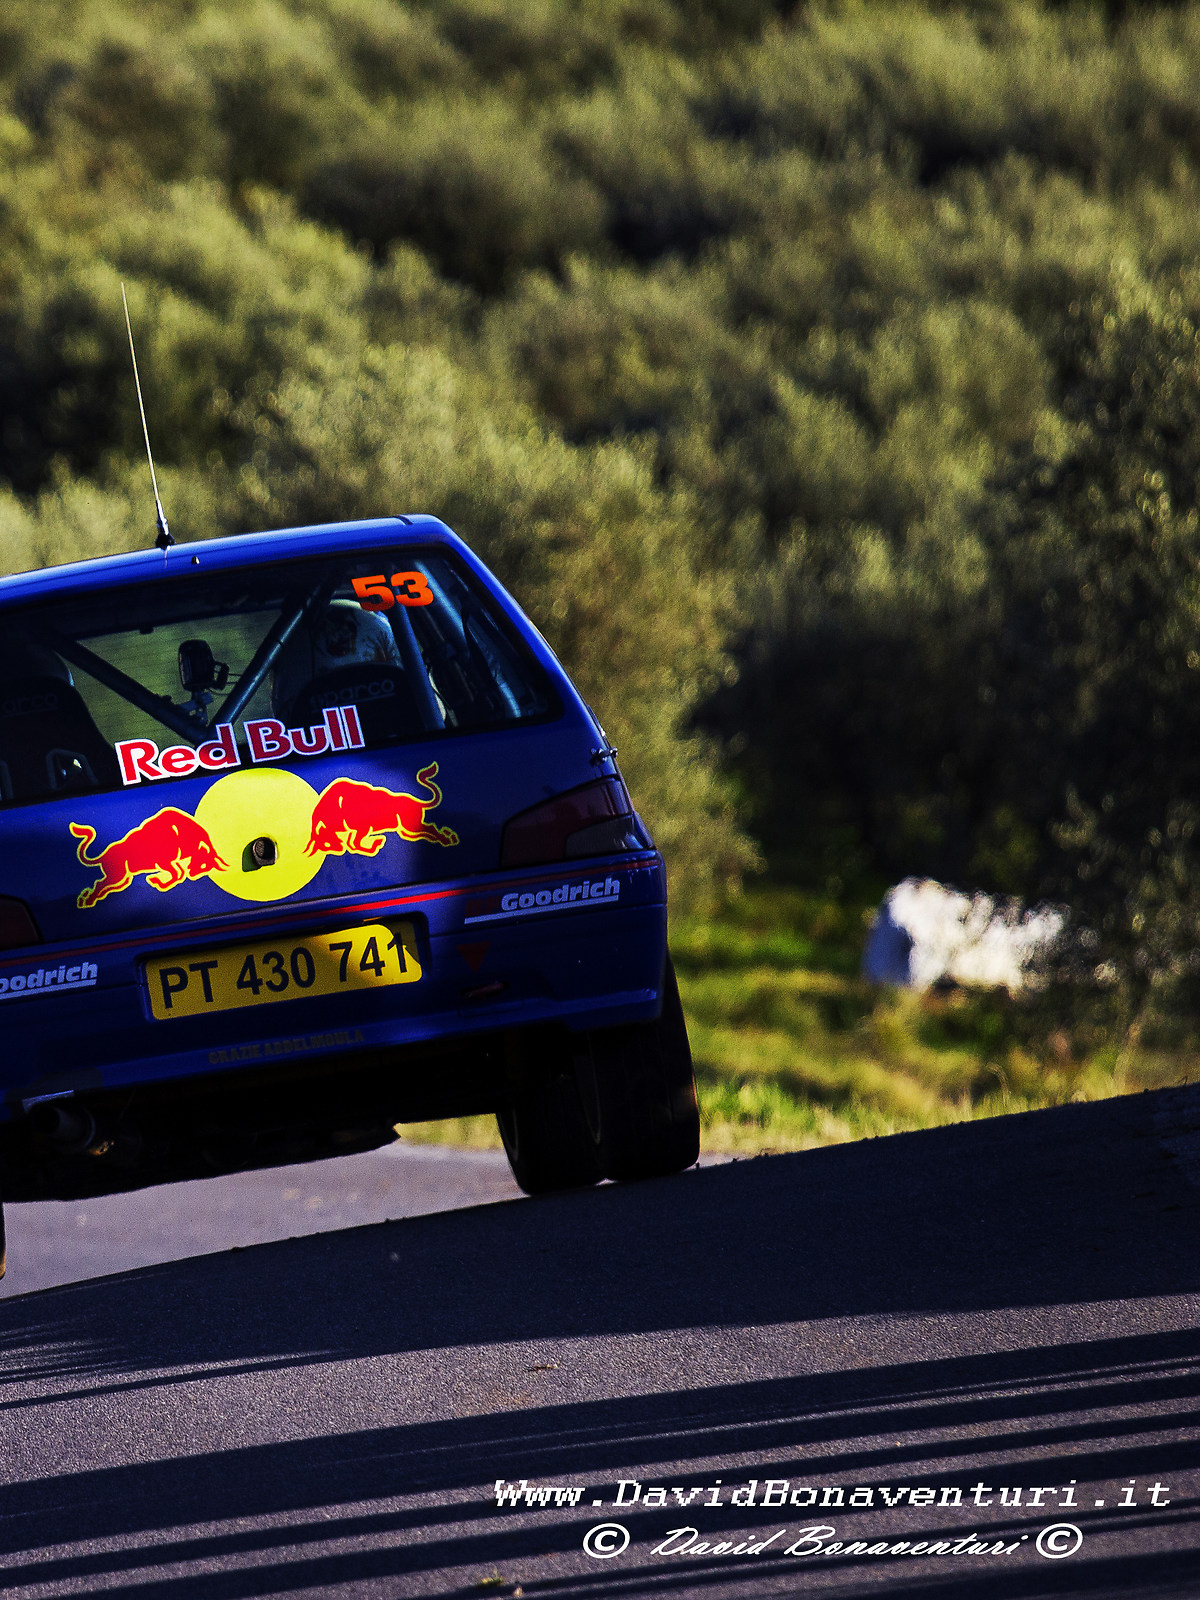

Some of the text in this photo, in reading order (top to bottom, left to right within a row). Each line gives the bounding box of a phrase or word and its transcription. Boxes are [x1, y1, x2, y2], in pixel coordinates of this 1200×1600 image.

[351, 571, 434, 612] 53
[114, 704, 366, 786] Red Bull
[159, 932, 408, 1009] PT 430 741
